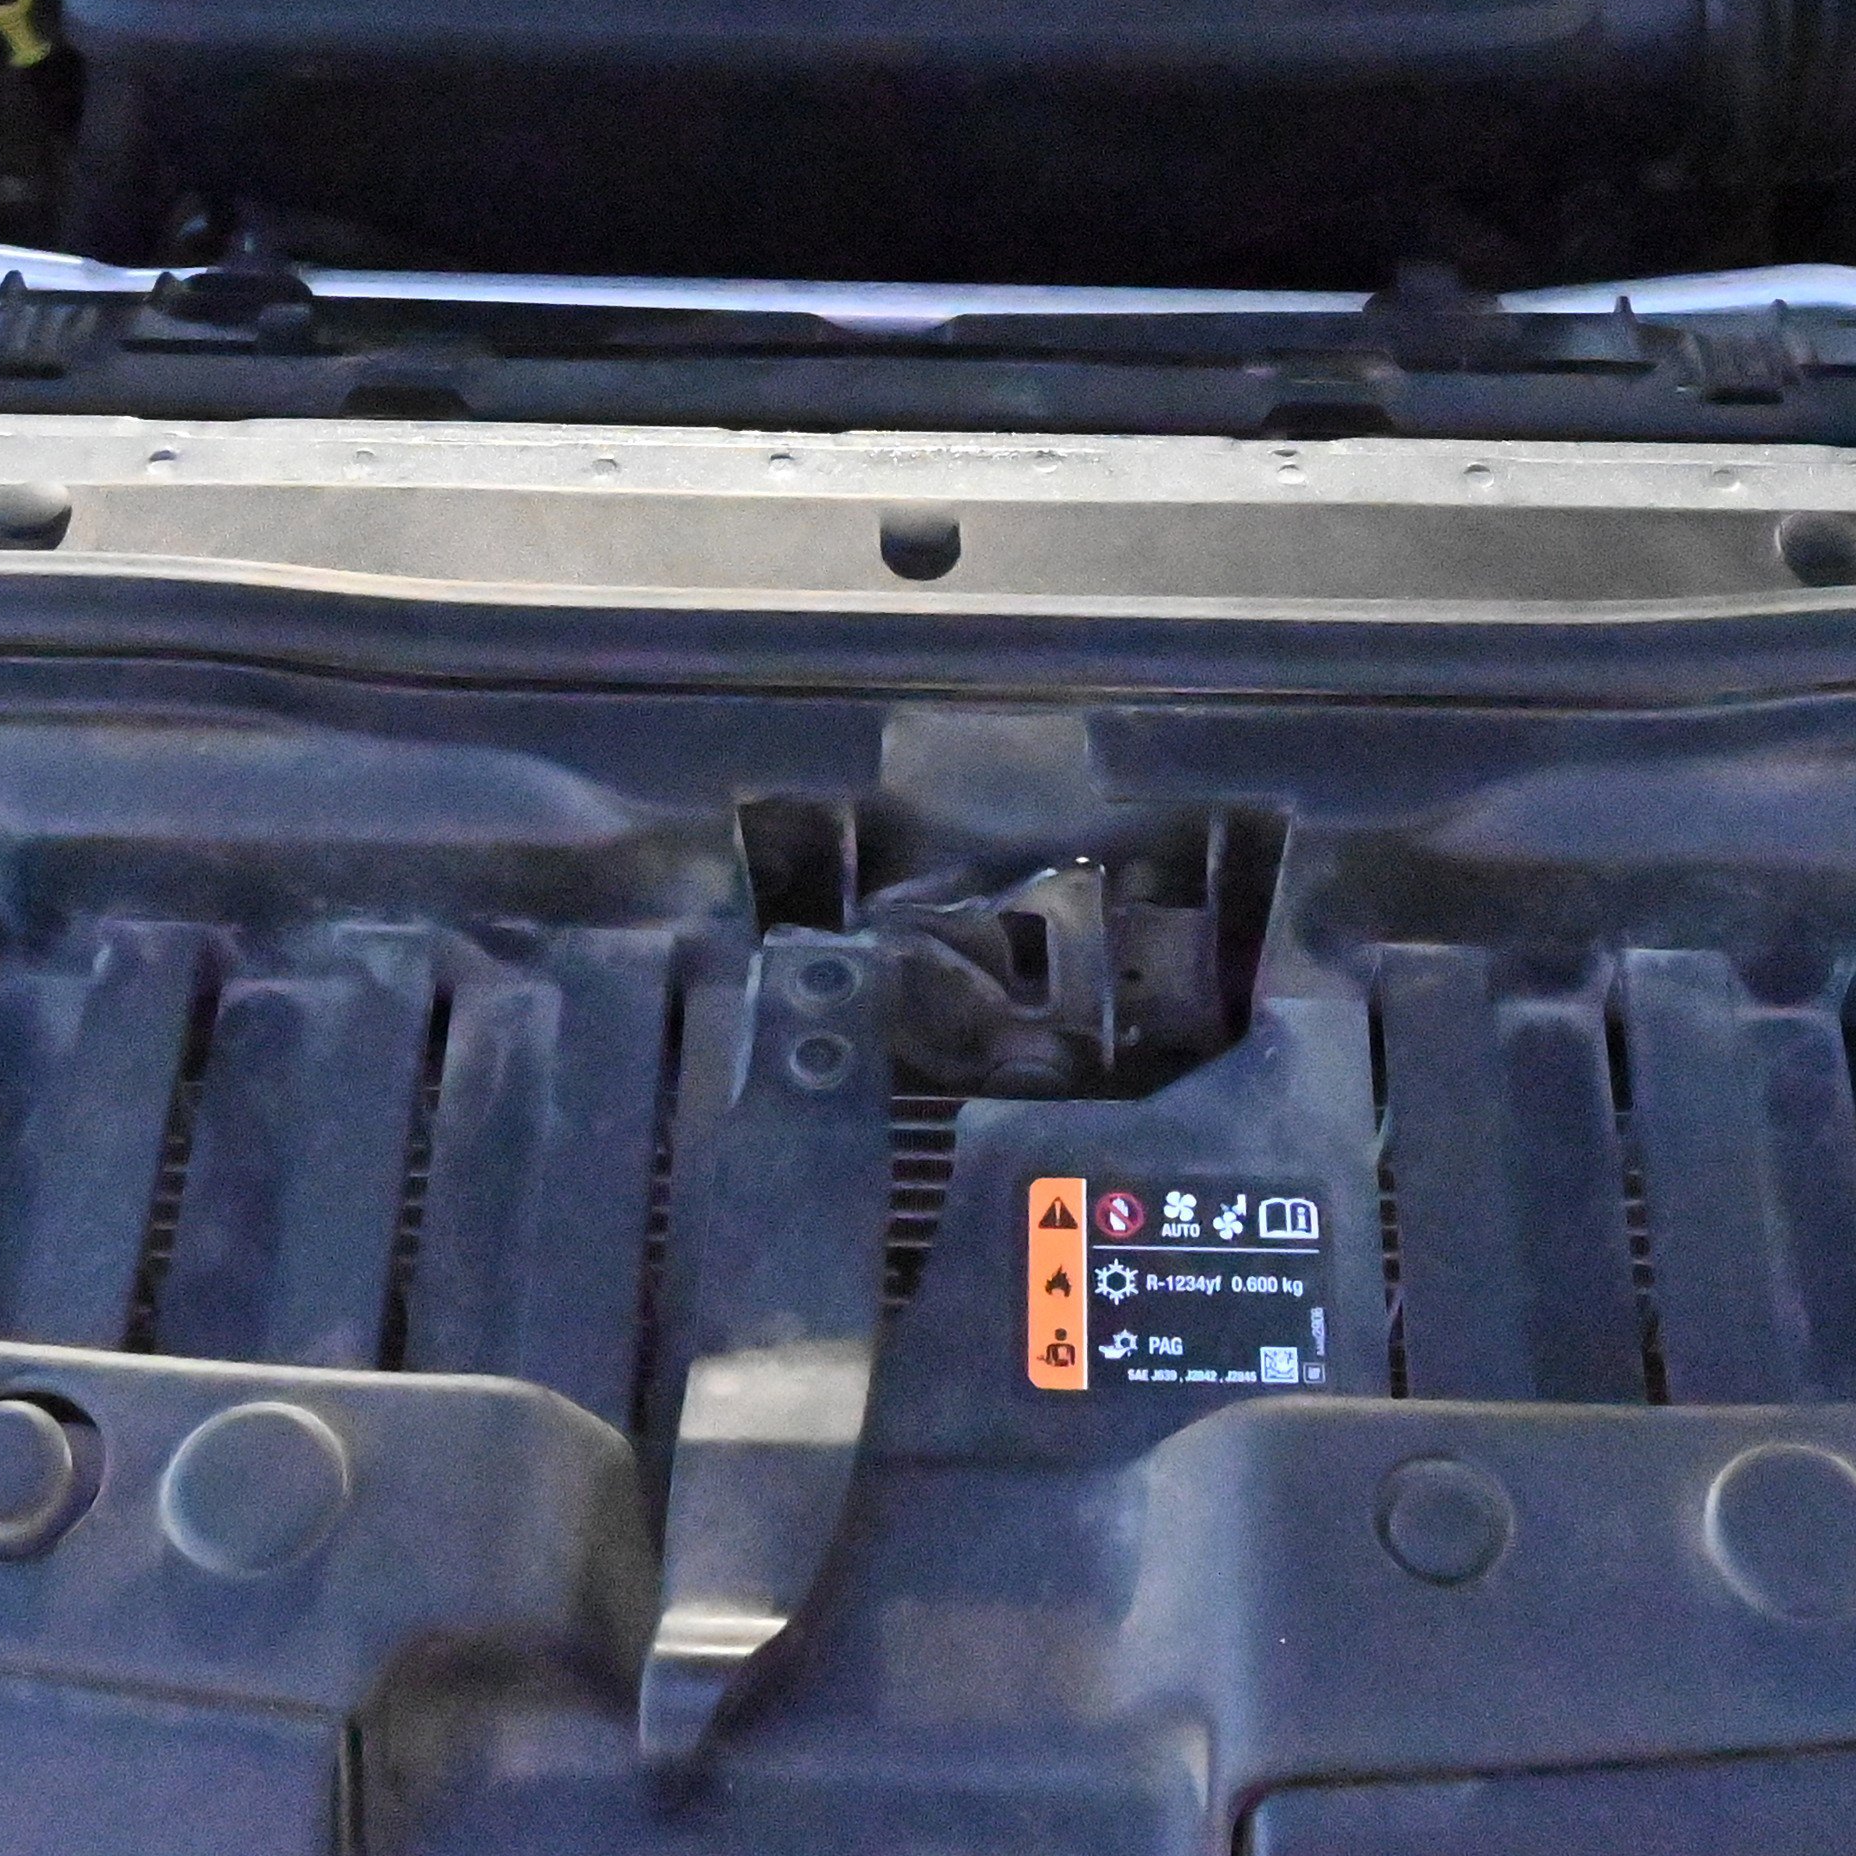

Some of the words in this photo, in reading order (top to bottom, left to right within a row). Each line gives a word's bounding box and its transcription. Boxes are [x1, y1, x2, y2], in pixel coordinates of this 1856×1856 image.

[1161, 1222, 1201, 1238] AUTO
[1146, 1274, 1222, 1296] R-1234yf
[1231, 1275, 1278, 1293] 0.600
[1282, 1276, 1304, 1297] kg
[1148, 1336, 1184, 1356] PAG
